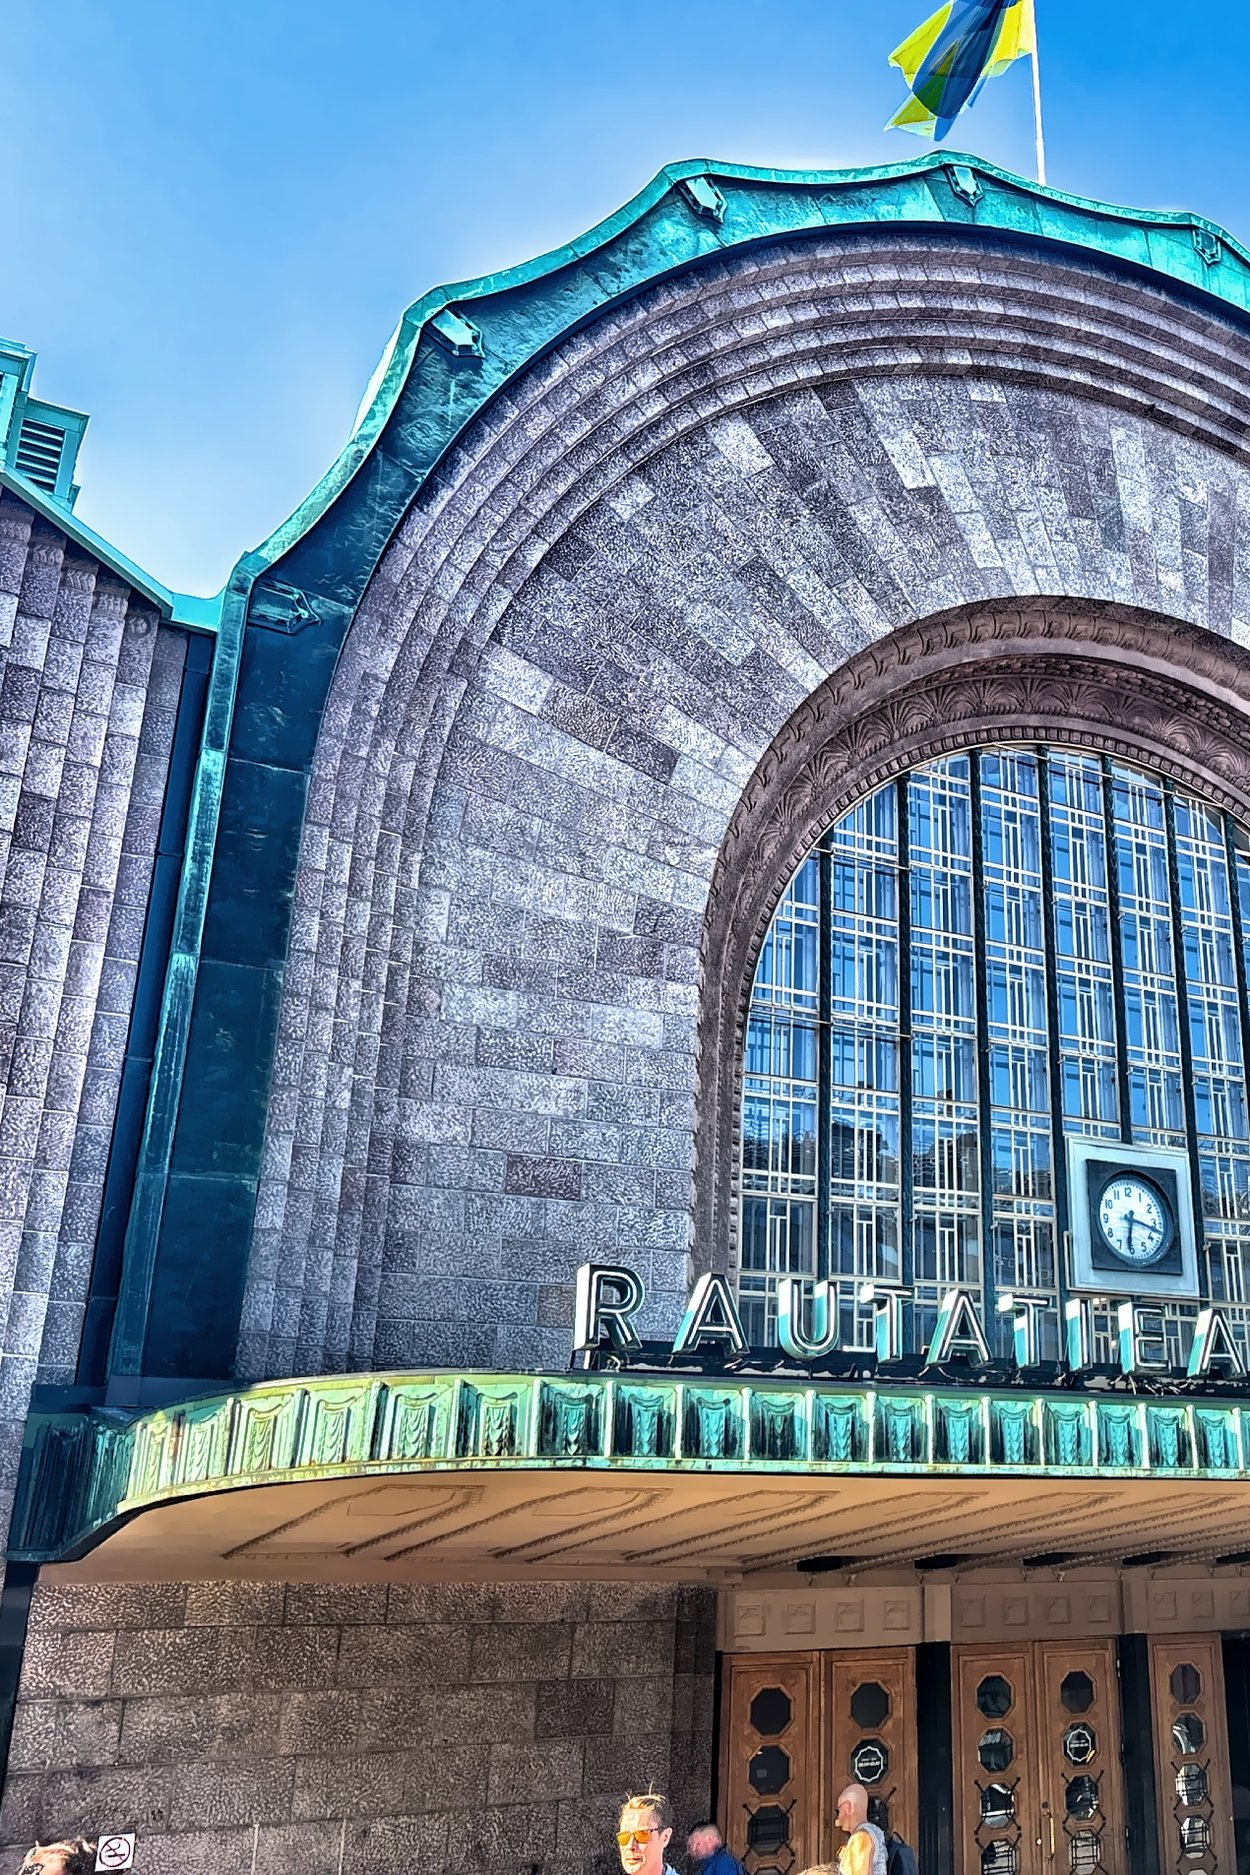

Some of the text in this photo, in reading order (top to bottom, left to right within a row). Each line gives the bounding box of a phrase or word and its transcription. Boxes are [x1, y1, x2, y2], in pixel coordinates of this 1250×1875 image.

[1113, 1189, 1120, 1200] 11
[1124, 1187, 1132, 1197] 12
[1105, 1199, 1113, 1209] 10
[1146, 1203, 1152, 1214] 2
[1103, 1213, 1109, 1224] 9
[1150, 1218, 1157, 1229] 3
[1107, 1227, 1114, 1238] 8
[1147, 1231, 1154, 1242] 4
[1116, 1239, 1122, 1250] 7
[1129, 1244, 1135, 1255] 6
[1141, 1241, 1147, 1252] 5
